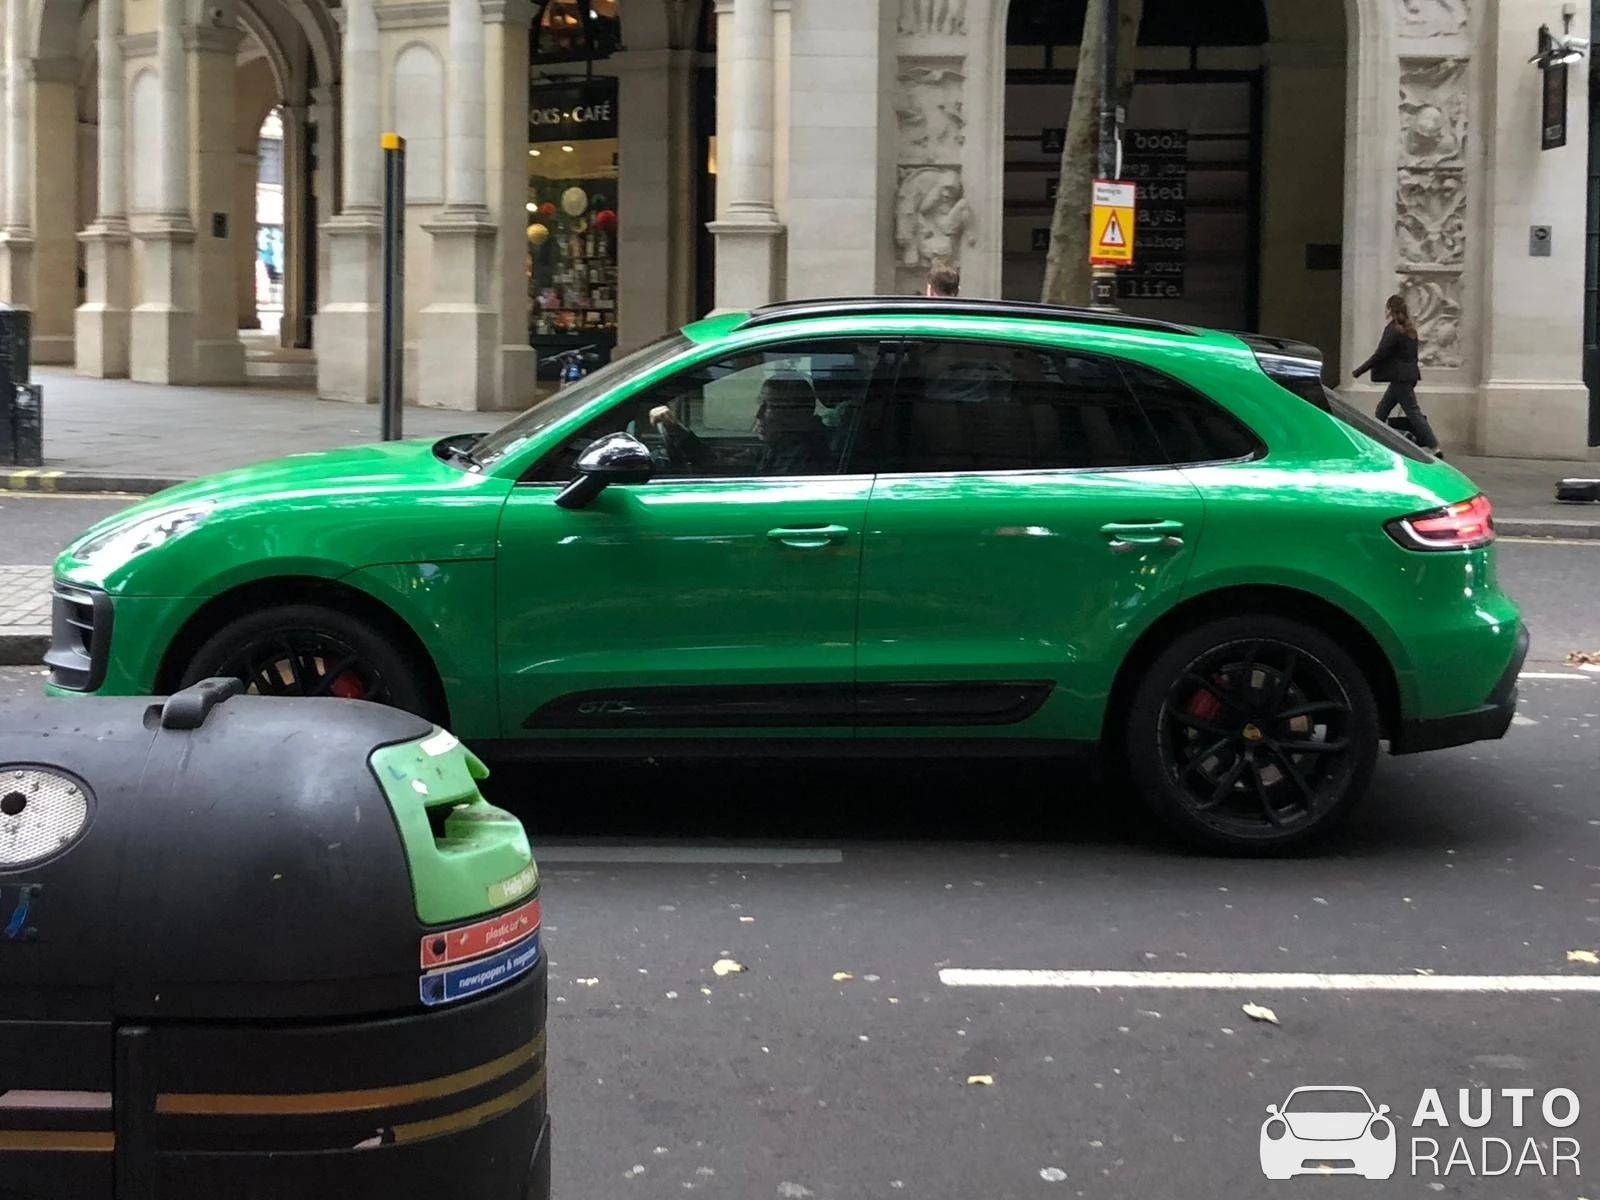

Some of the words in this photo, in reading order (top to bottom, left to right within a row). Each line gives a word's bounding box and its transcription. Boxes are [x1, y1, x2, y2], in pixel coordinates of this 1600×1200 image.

[530, 107, 560, 125] OKS
[572, 100, 611, 123] CAFÉ
[1134, 132, 1186, 149] book
[1136, 183, 1185, 200] ated
[1138, 209, 1182, 226] ays.
[459, 964, 506, 988] newspapers
